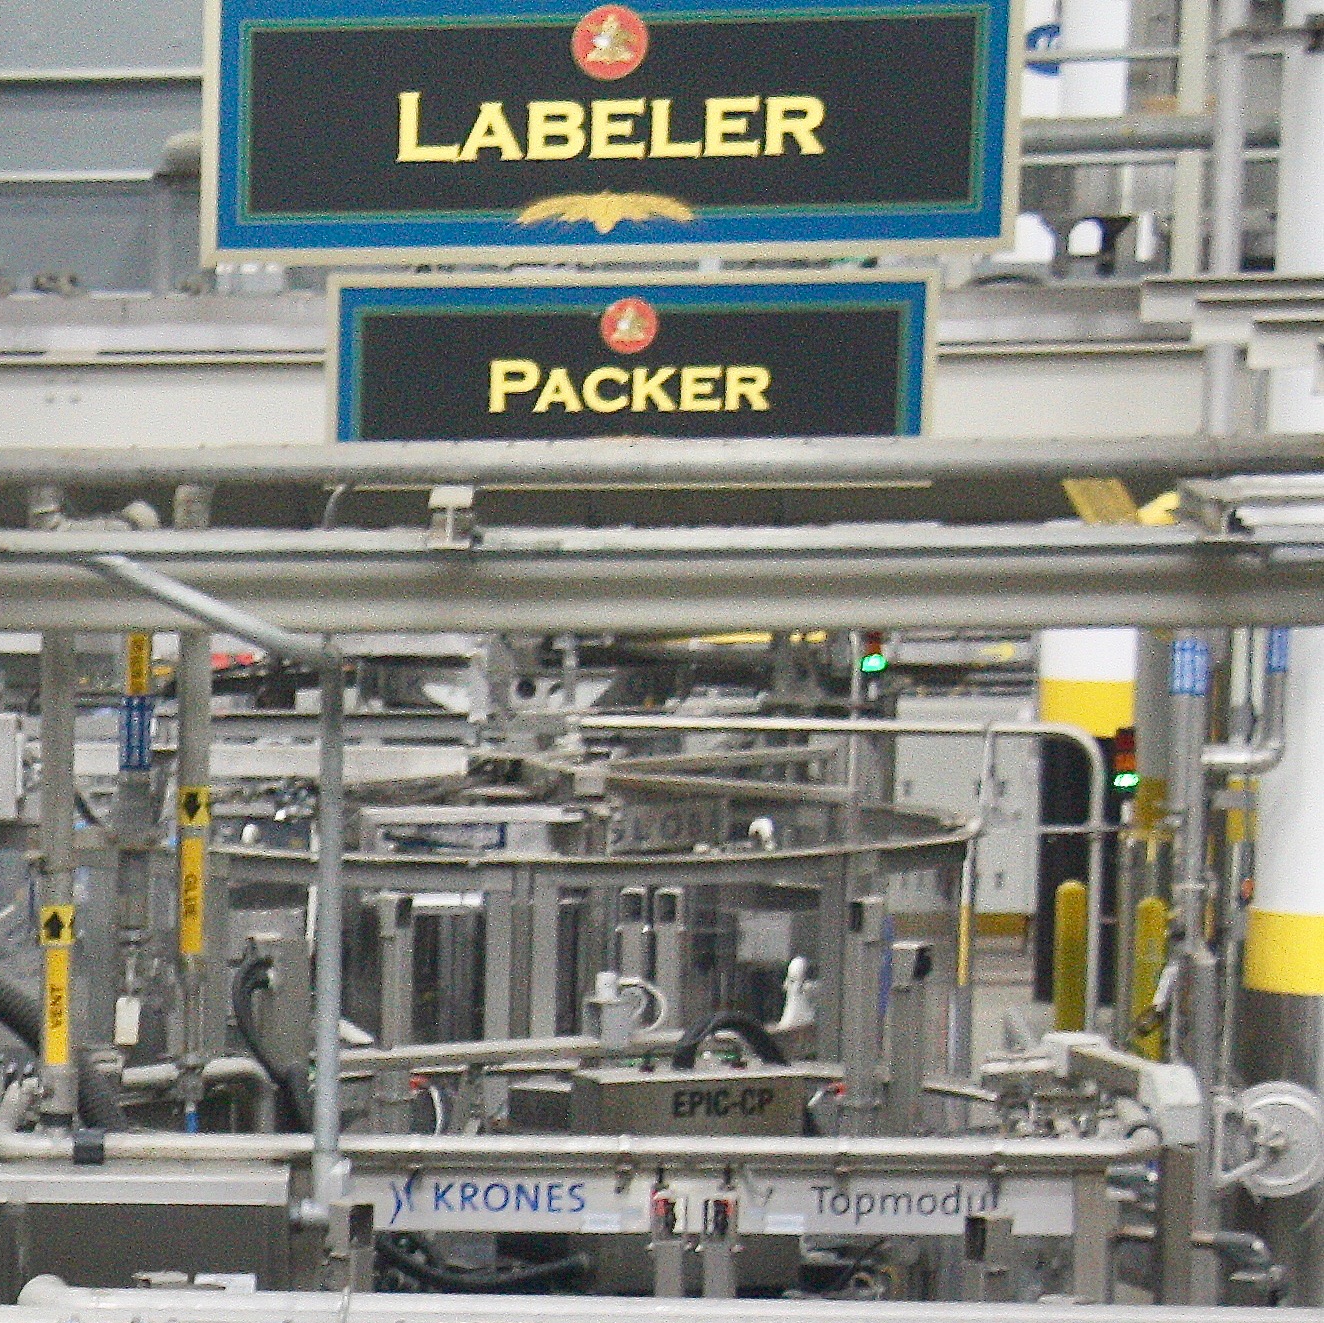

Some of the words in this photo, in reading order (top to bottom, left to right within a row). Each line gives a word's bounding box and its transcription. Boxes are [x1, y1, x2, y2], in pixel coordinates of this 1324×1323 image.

[395, 90, 826, 163] LABELER
[486, 357, 773, 414] PACKER
[433, 1181, 586, 1213] KRONES
